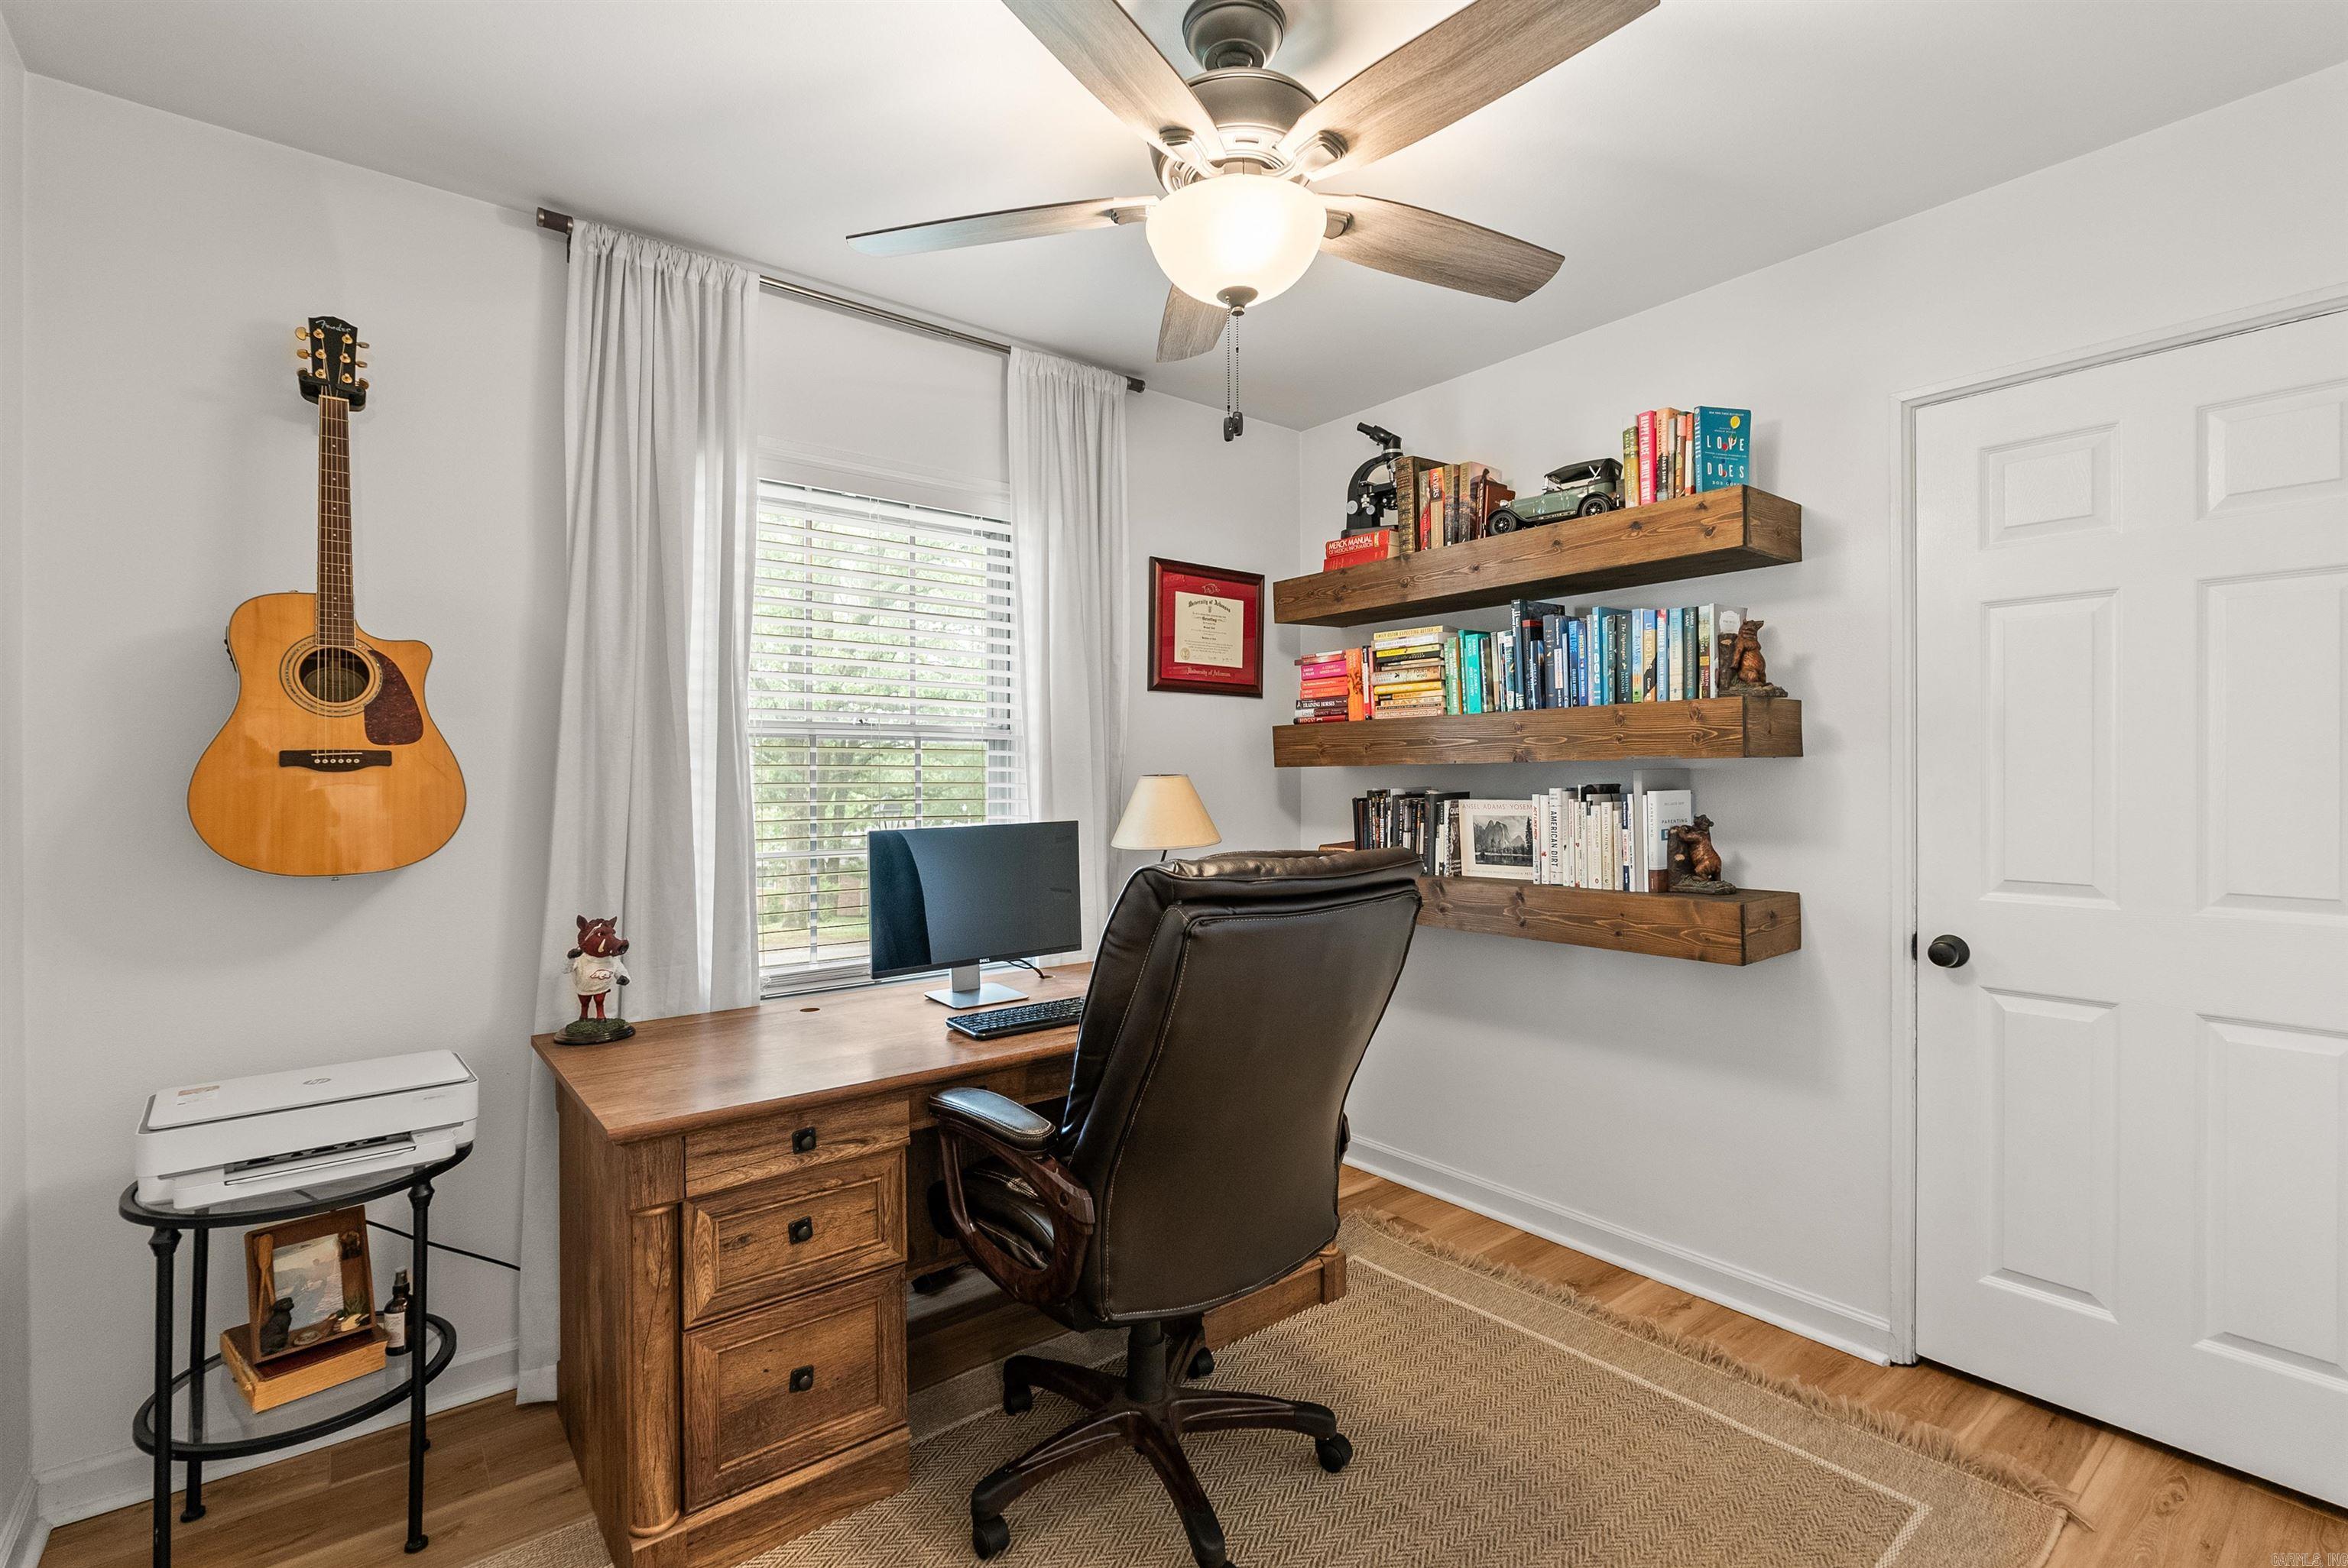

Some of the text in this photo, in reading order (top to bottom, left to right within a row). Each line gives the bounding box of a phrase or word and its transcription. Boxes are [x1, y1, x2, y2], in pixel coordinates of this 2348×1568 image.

[315, 319, 352, 332] Fender
[1640, 415, 1649, 434] HAPPY
[1640, 437, 1649, 456] PLACE
[1707, 436, 1744, 452] LOVE
[1641, 460, 1649, 478] EMILY
[1707, 462, 1744, 478] DOES
[1328, 535, 1372, 549] MERCK MANUAL
[1349, 543, 1373, 551] INFORMATION
[1646, 641, 1652, 652] NO
